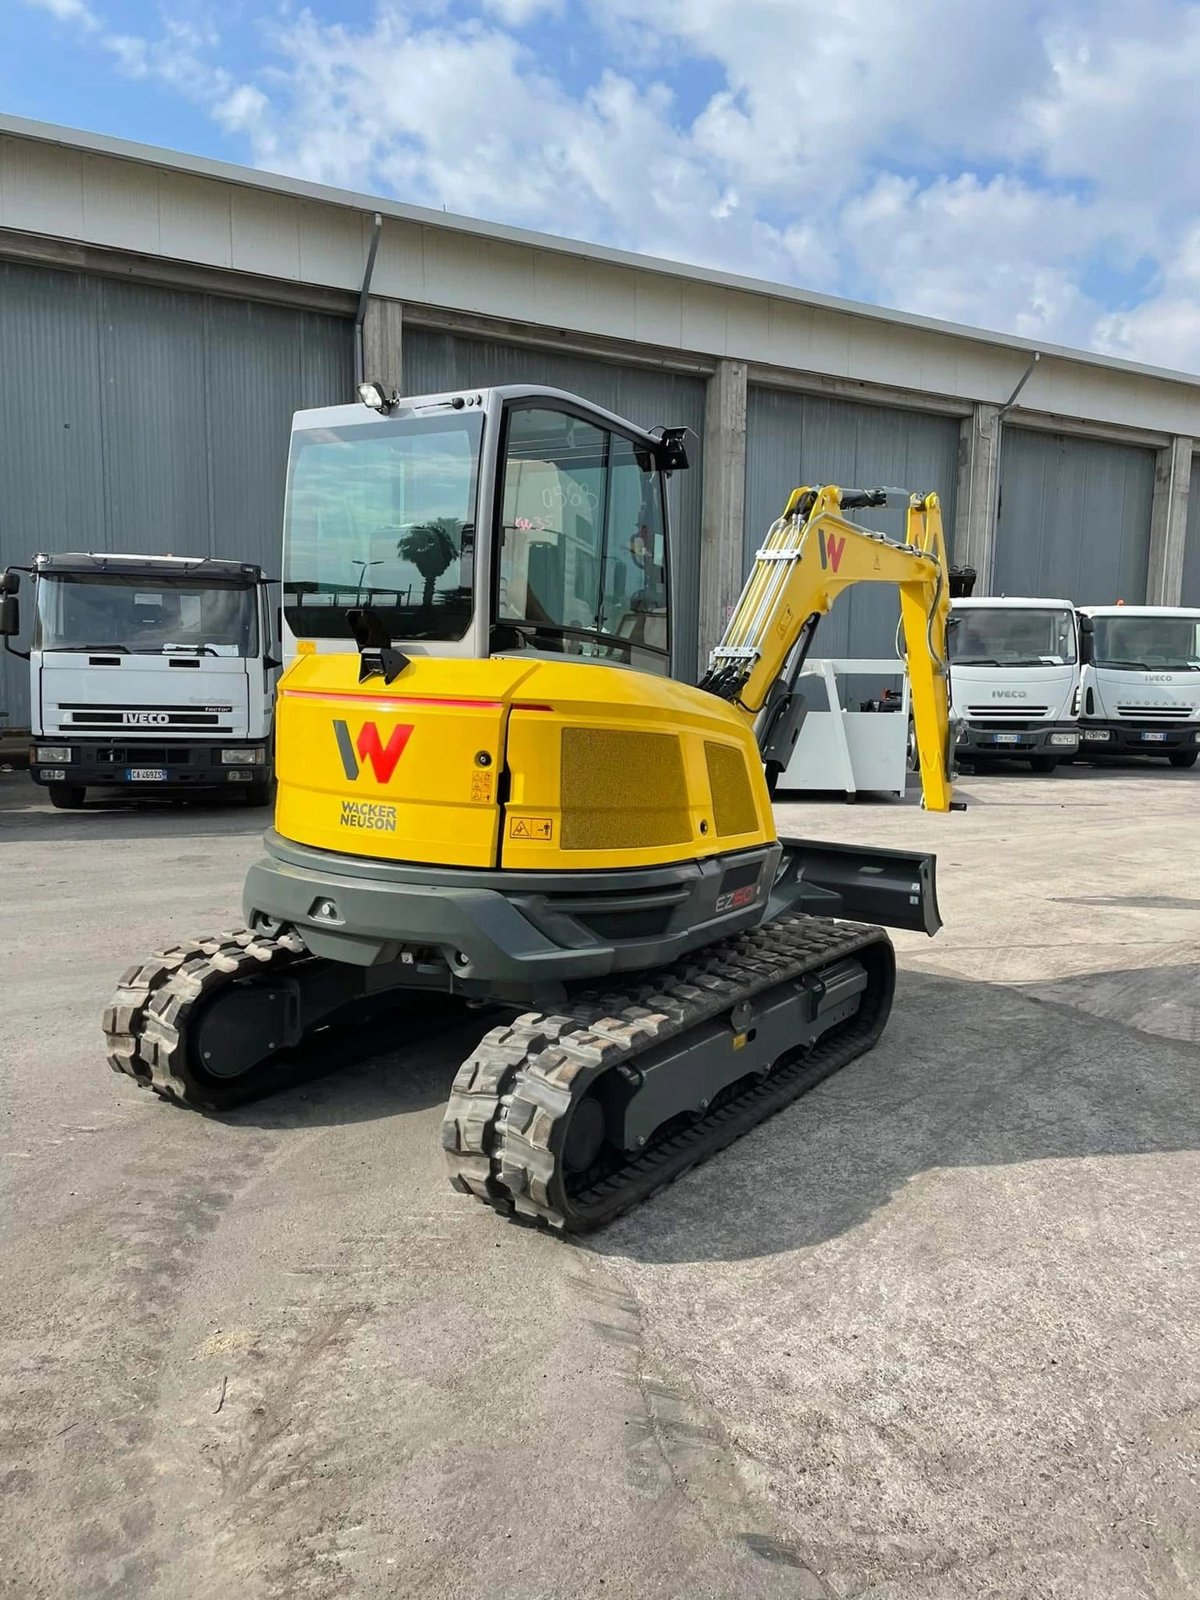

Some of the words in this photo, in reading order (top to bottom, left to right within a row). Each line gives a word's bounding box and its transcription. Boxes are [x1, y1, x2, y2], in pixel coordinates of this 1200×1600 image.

[992, 690, 1027, 698] IVECO
[122, 714, 169, 724] IVECO
[341, 800, 397, 819] WACKER
[340, 813, 397, 832] NEUSON
